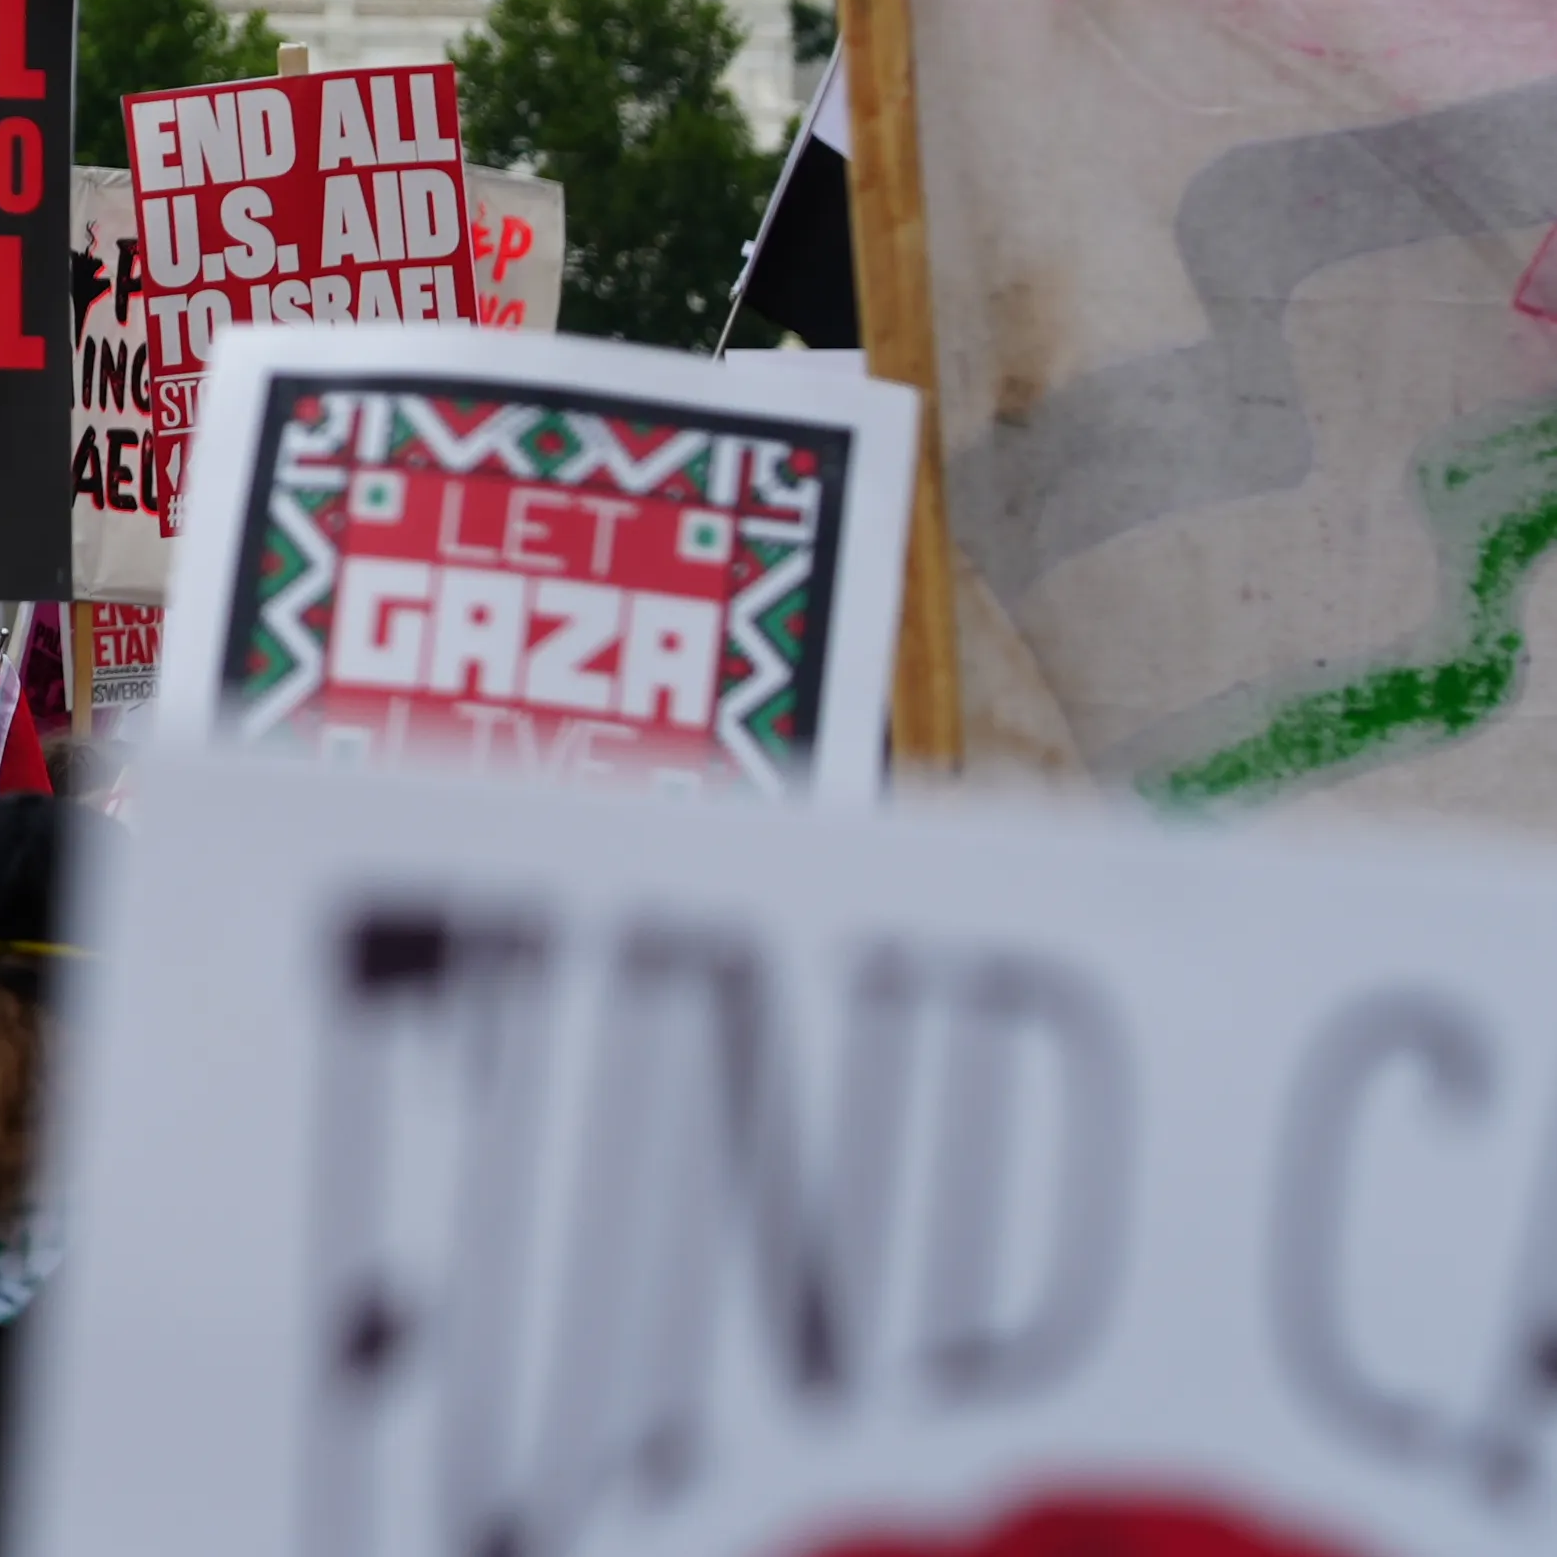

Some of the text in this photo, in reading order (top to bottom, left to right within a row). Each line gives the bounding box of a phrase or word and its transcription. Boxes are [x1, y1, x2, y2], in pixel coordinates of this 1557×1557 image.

[131, 73, 457, 193] END ALL
[141, 186, 300, 288] U.S.
[320, 168, 461, 270] AID
[438, 479, 638, 578] LET
[328, 556, 724, 730] GAZA
